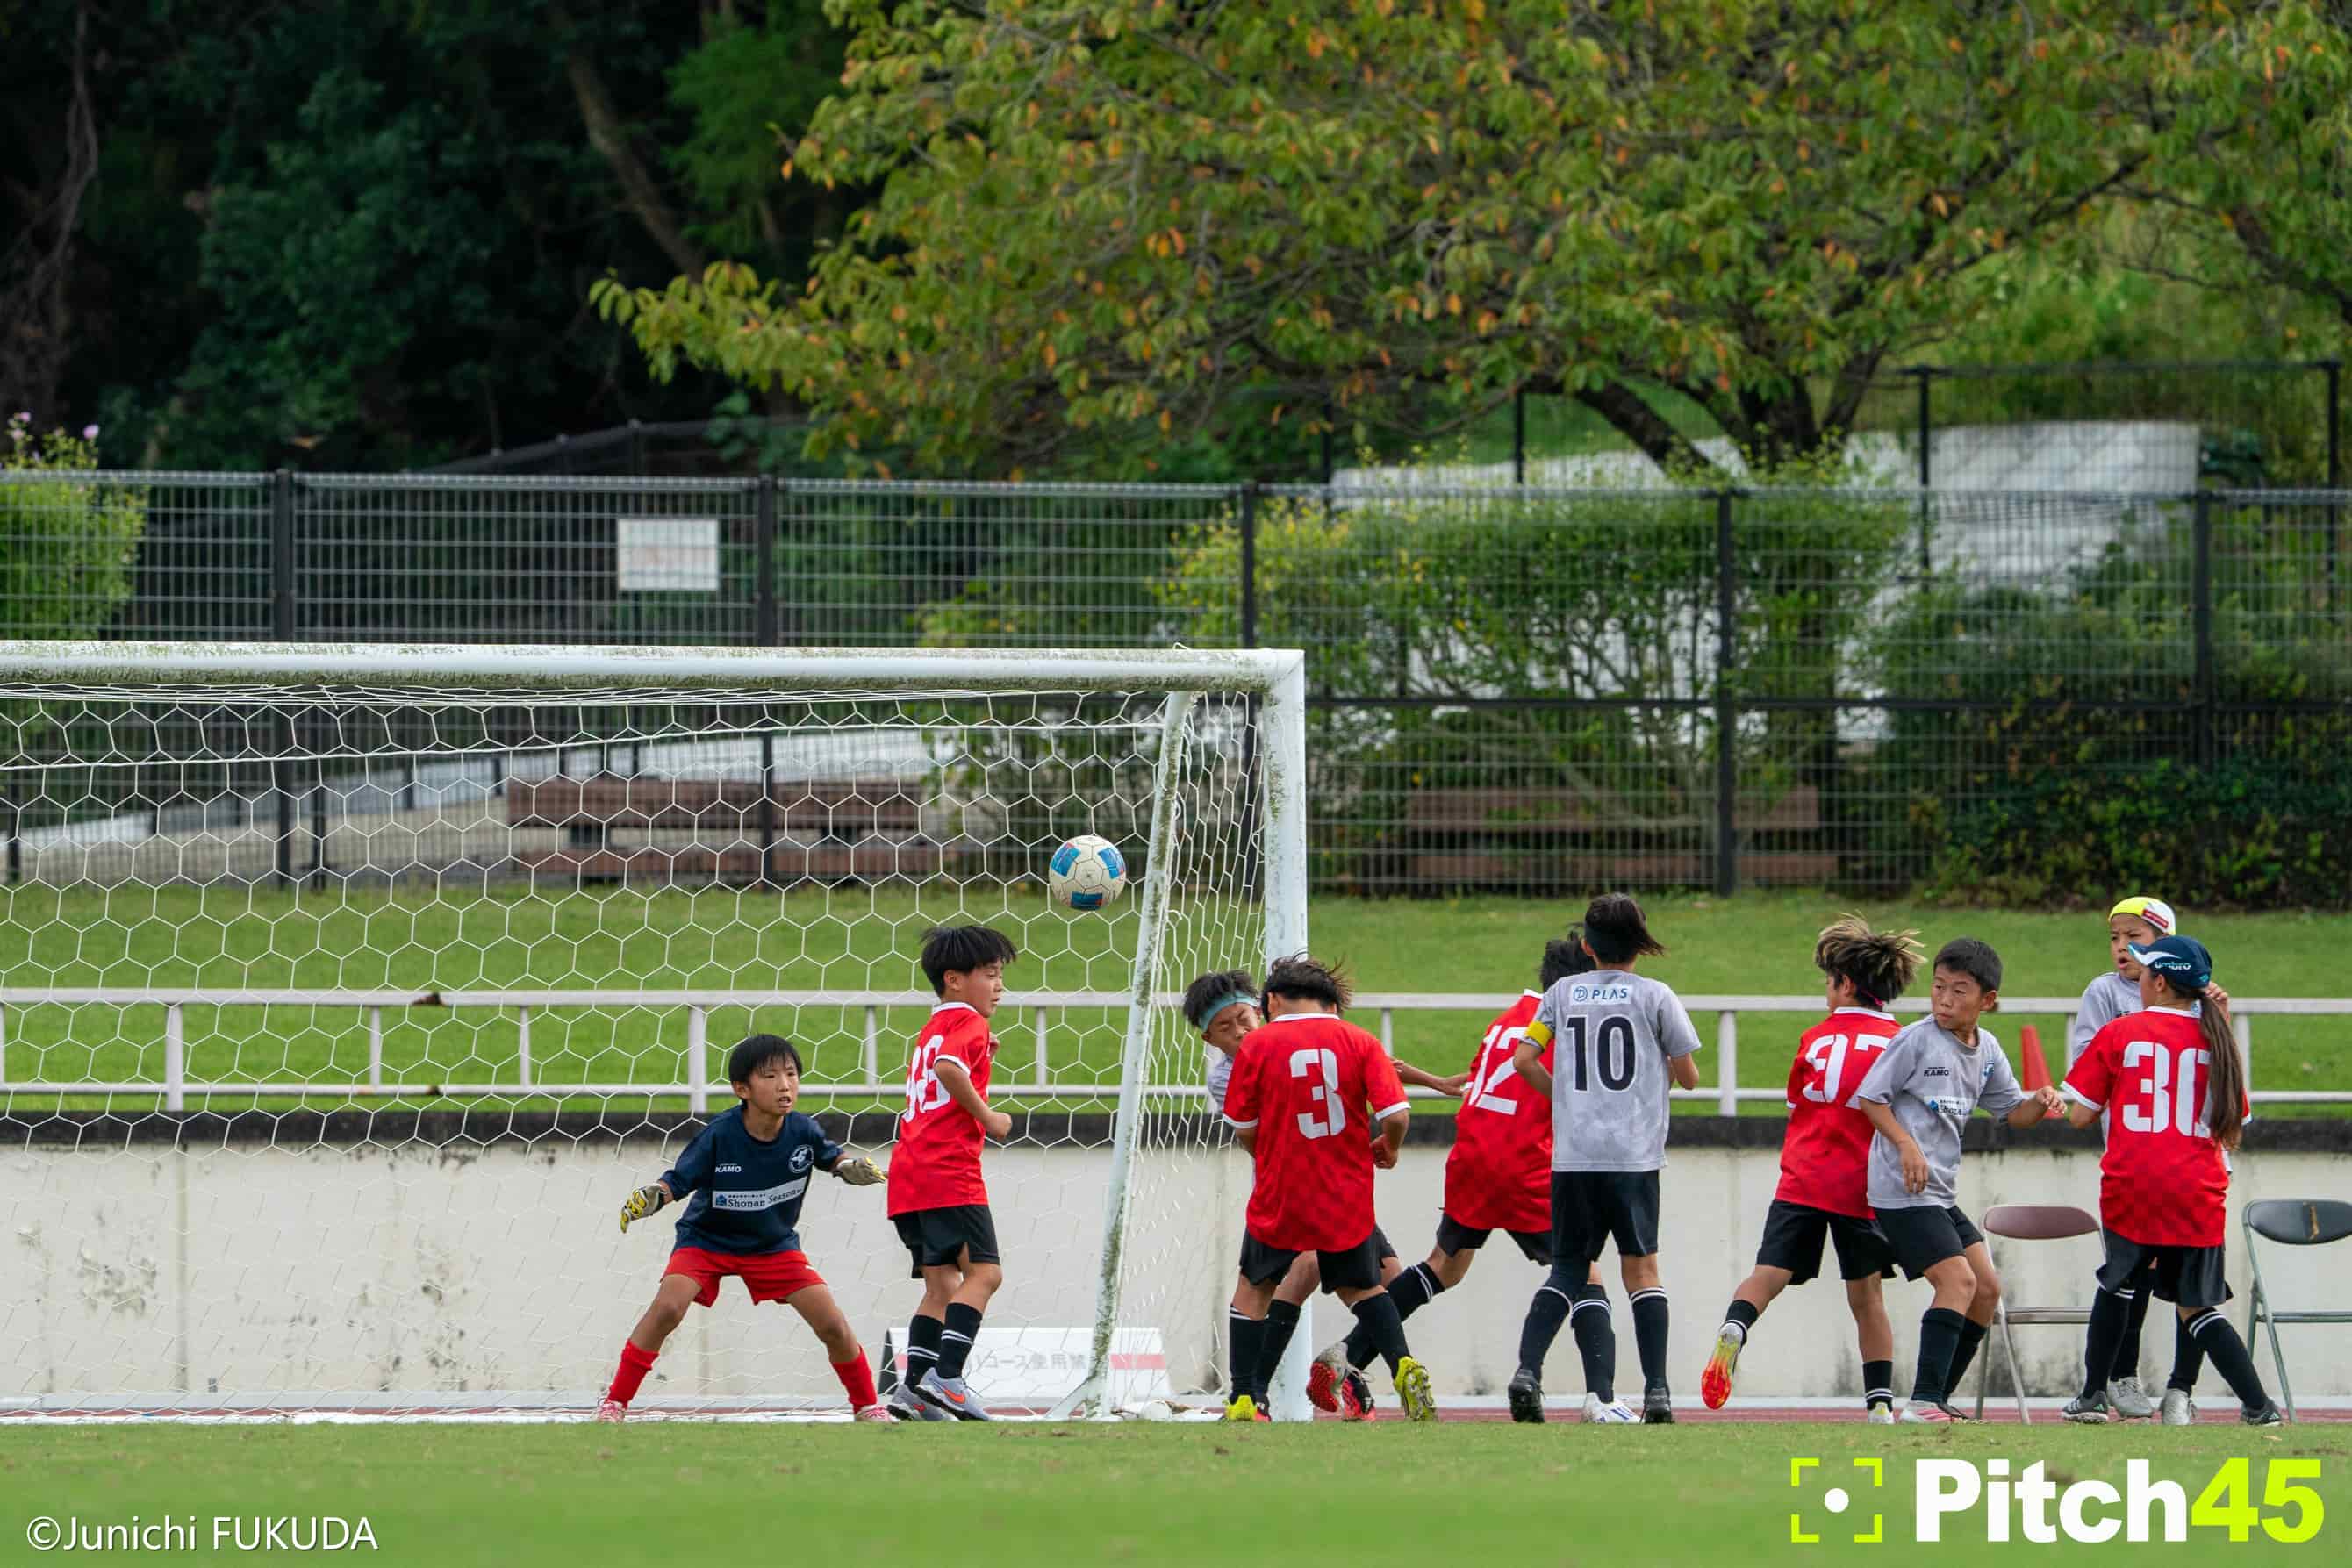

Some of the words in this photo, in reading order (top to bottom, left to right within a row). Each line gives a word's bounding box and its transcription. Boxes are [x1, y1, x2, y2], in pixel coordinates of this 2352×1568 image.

[1592, 988, 1628, 1000] PLAS
[2155, 961, 2191, 970] umbro
[1467, 1025, 1529, 1116] 12
[1566, 1013, 1637, 1093] 10
[1802, 1033, 1890, 1110] 97
[2122, 1041, 2212, 1139] 30
[1289, 1048, 1346, 1139] 3
[728, 1199, 766, 1208] Shonan
